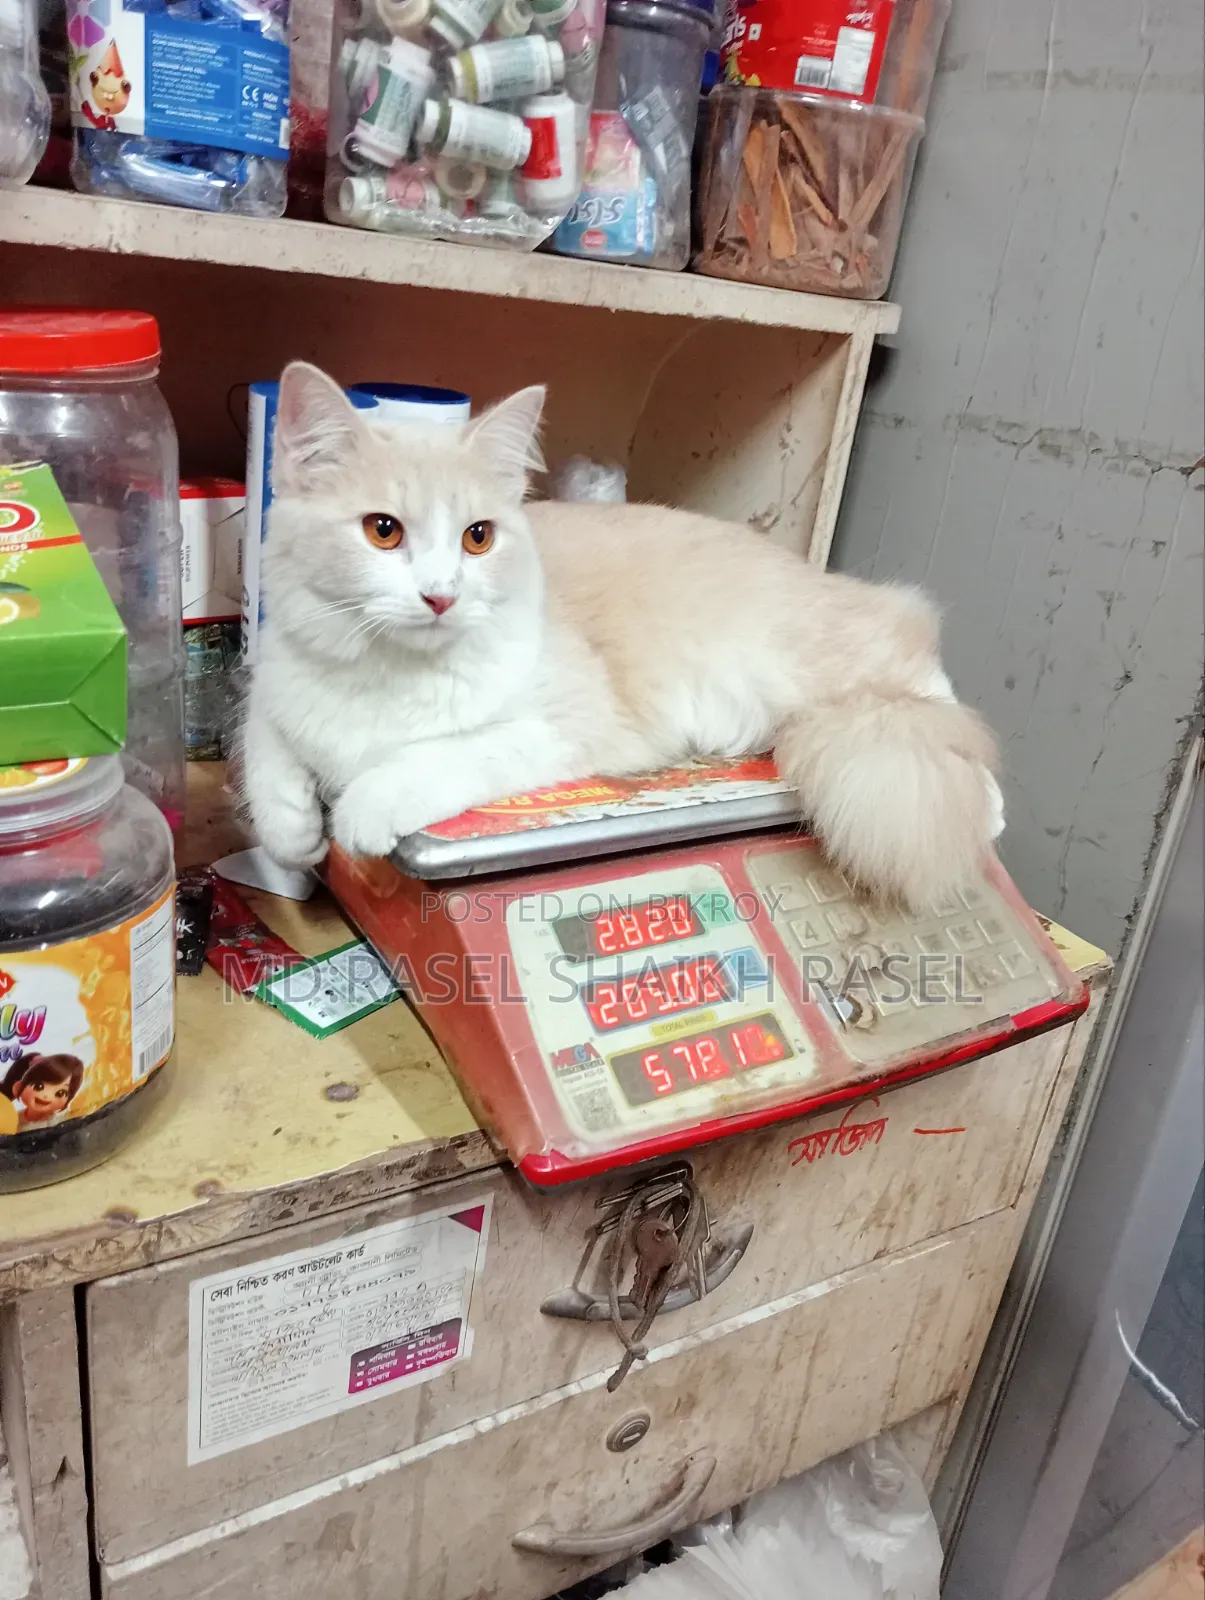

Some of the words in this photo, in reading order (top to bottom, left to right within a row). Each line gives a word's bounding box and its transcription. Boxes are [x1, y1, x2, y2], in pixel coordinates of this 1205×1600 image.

[804, 921, 819, 942] 4
[210, 1286, 233, 1302] সেবা
[237, 1275, 269, 1297] নিশ্চিত
[272, 1268, 295, 1283] করণ
[297, 1251, 344, 1278] আউটলেট
[345, 1243, 366, 1263] কার্ড
